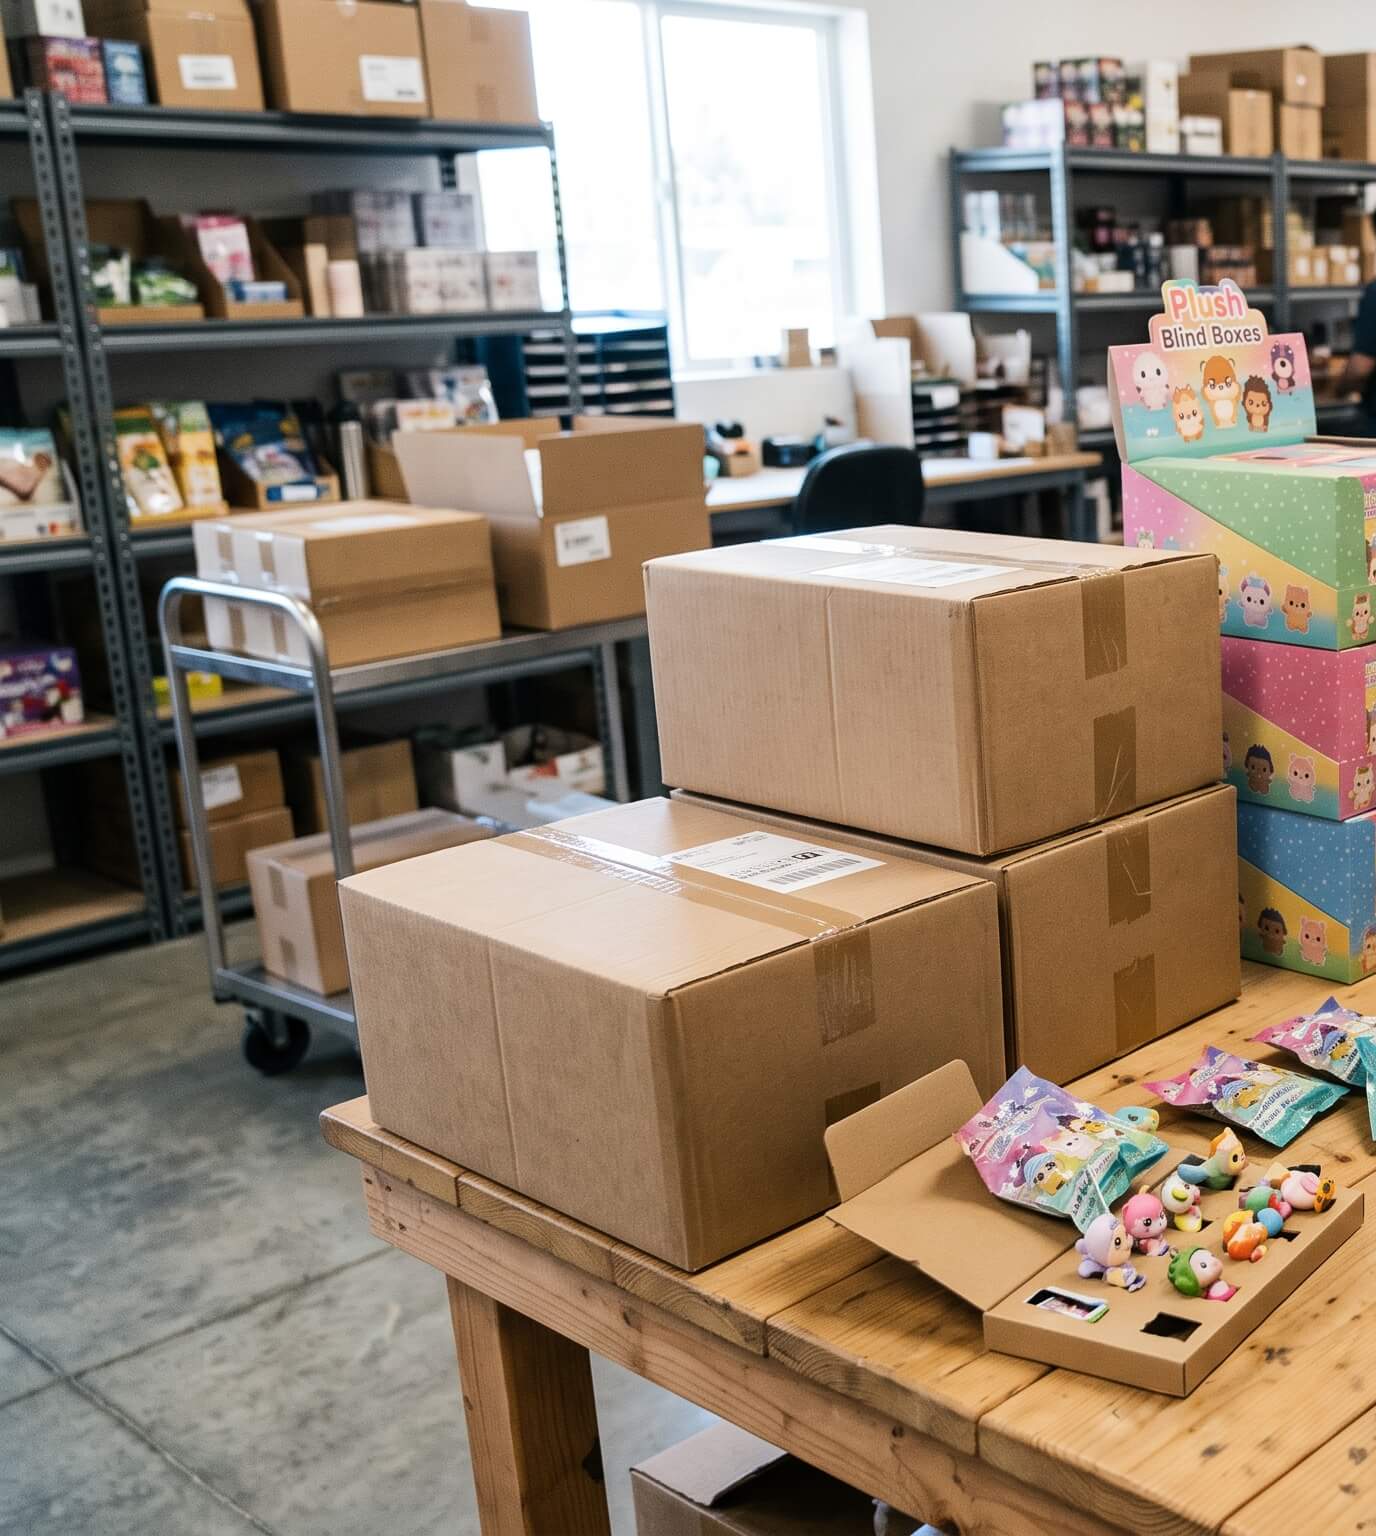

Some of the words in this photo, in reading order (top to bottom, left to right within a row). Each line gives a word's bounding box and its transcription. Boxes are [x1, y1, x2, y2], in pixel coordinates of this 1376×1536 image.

[1168, 286, 1243, 320] Plush
[1161, 326, 1207, 349] Blind
[1212, 325, 1261, 345] Boxes
